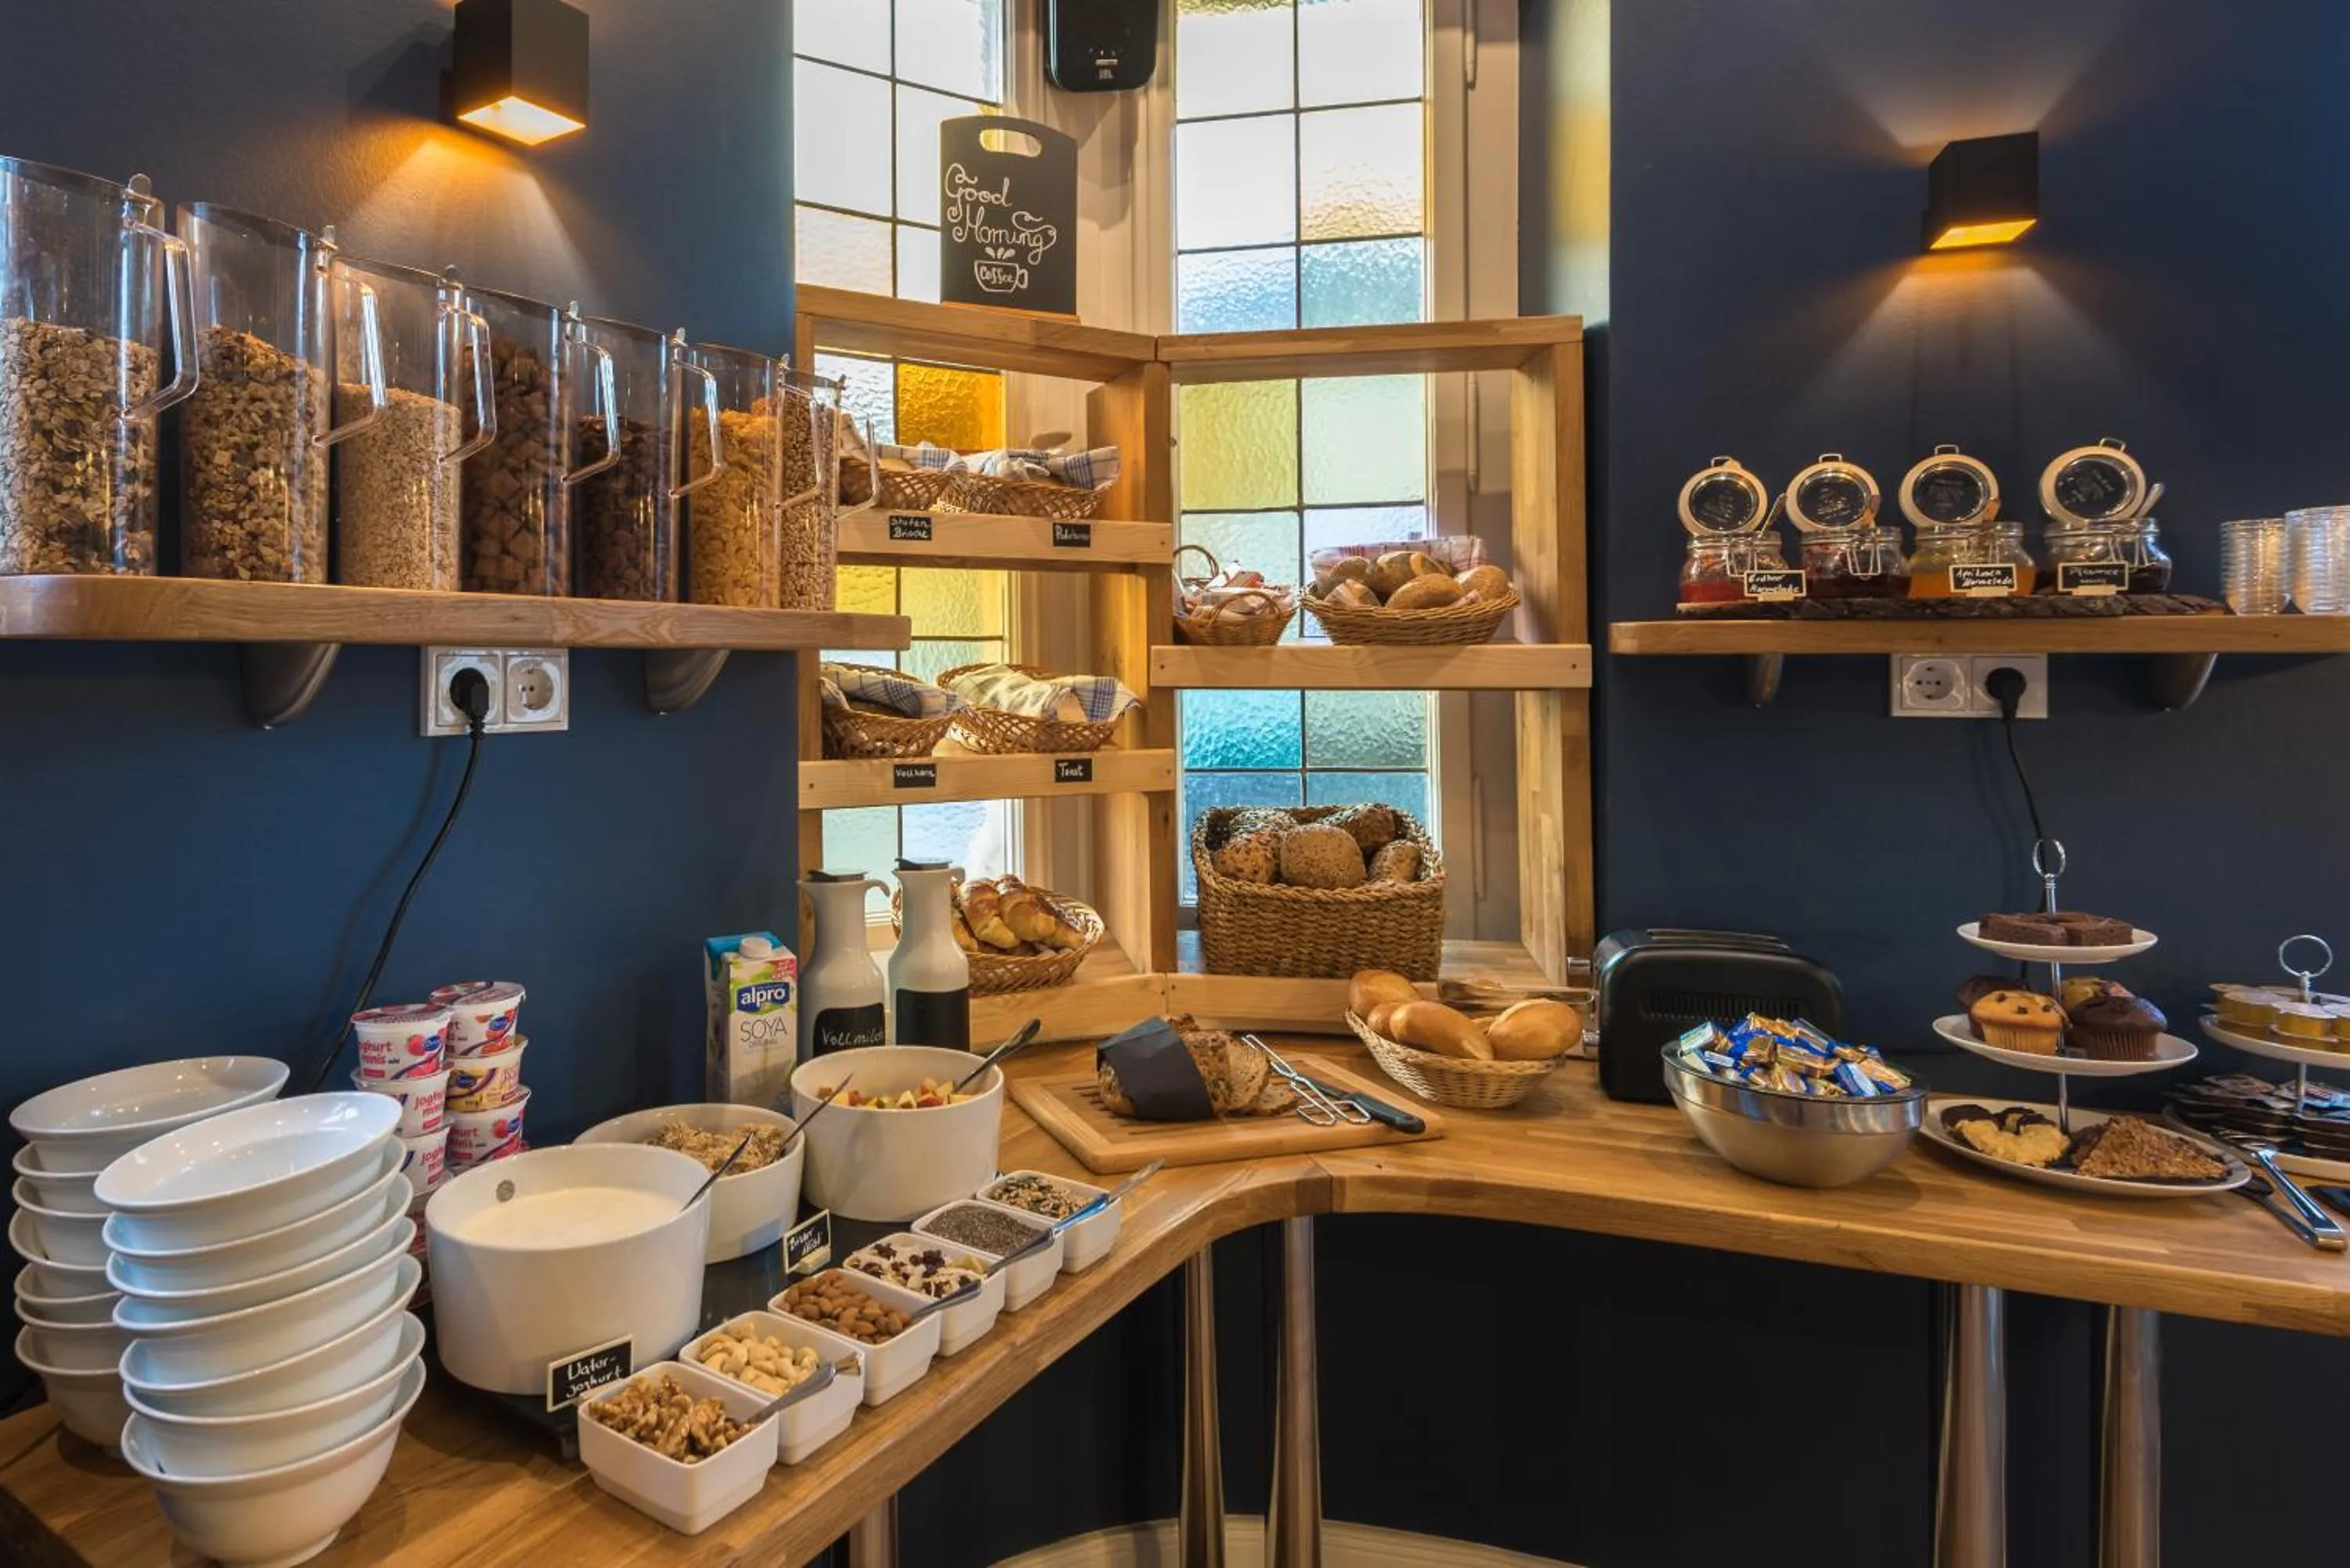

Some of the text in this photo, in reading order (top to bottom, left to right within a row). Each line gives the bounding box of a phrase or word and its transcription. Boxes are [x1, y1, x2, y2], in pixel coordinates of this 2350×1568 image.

[945, 163, 1012, 222] Good
[952, 204, 1057, 266] Morning
[979, 265, 1015, 284] Coffee
[740, 987, 786, 1007] alpro
[739, 1016, 787, 1042] SOYA
